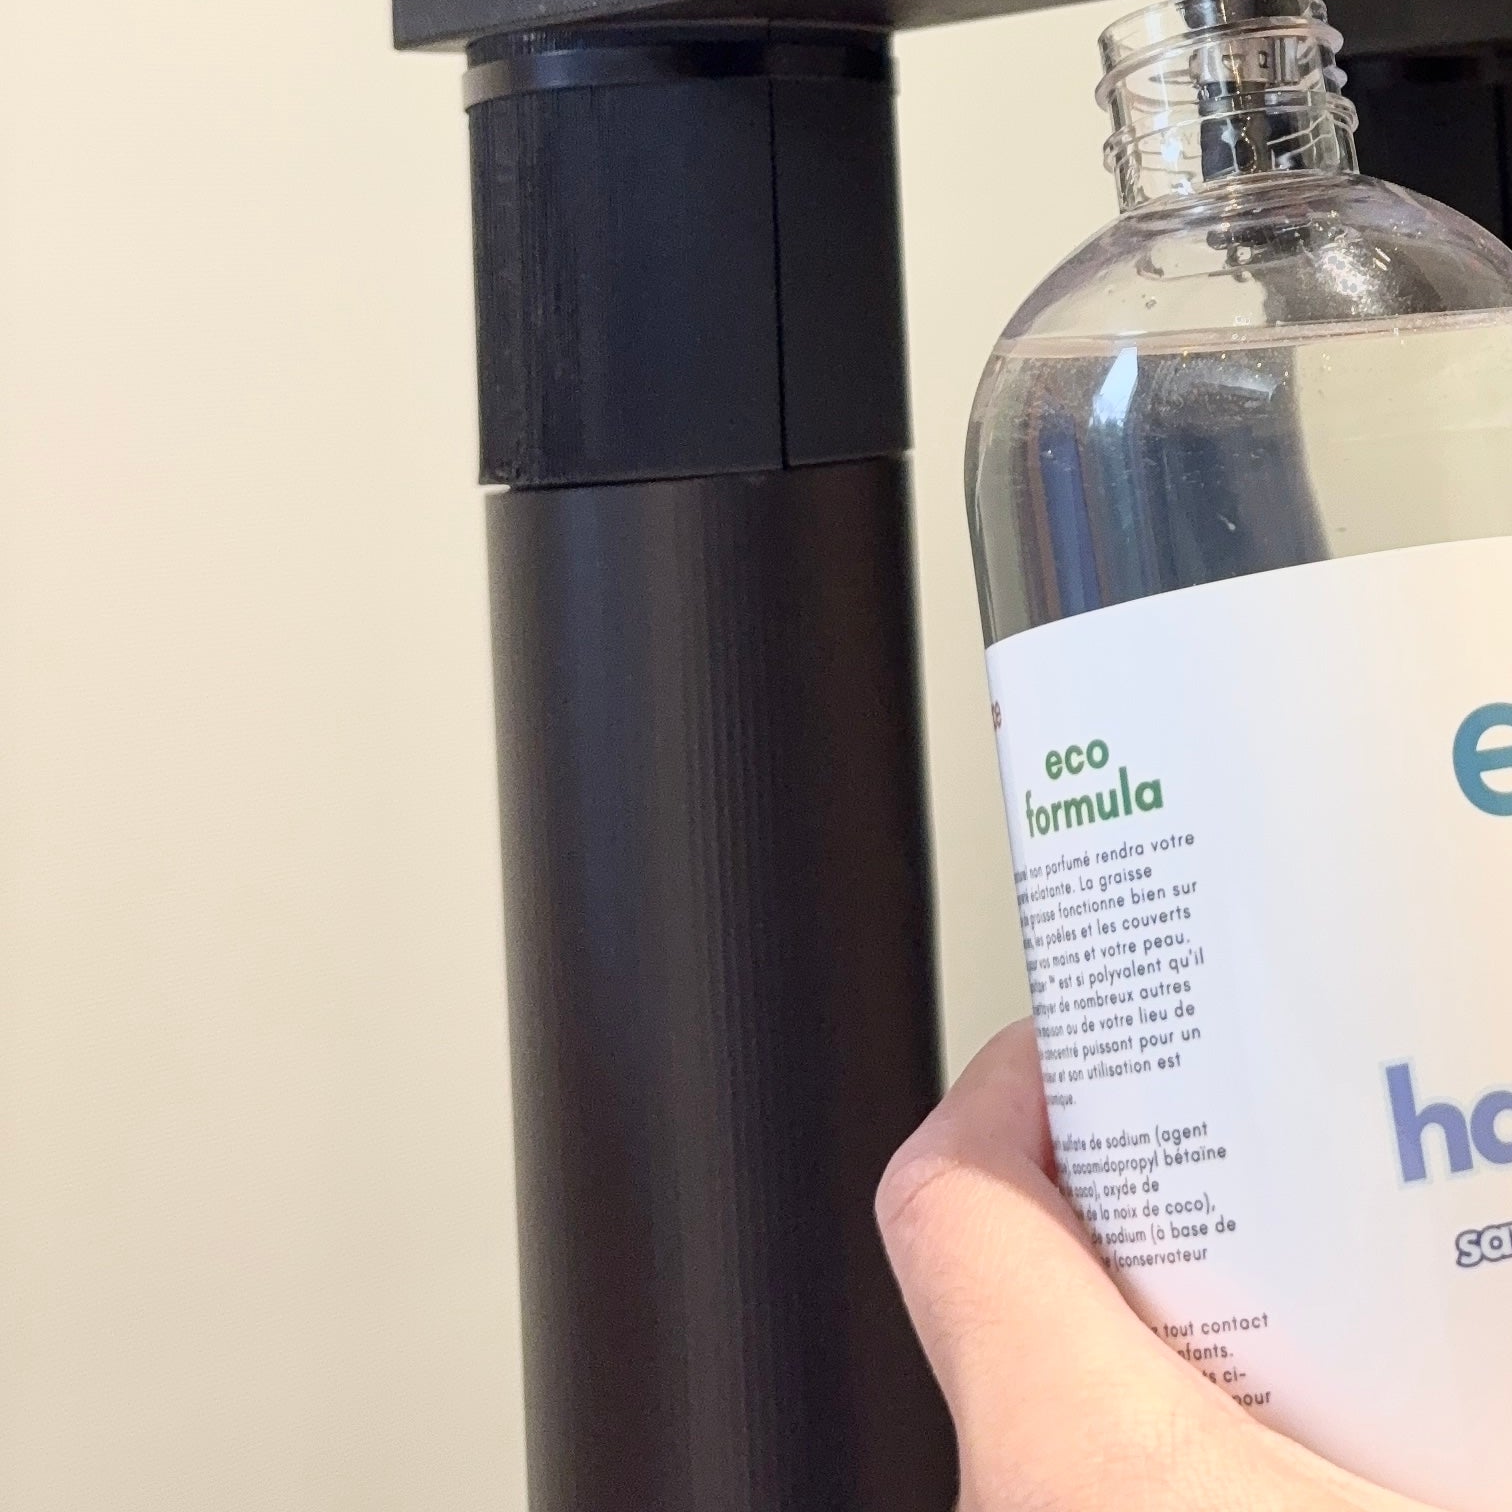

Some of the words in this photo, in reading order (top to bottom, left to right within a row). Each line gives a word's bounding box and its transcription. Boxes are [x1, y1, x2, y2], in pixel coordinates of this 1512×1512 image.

[1045, 738, 1110, 780] eco
[1025, 766, 1164, 838] formula
[1046, 851, 1090, 879] parfumé
[1096, 841, 1144, 863] rendra
[1151, 833, 1195, 852] votre
[1079, 876, 1094, 891] La
[1099, 866, 1153, 892] graisse
[1058, 896, 1125, 919] fonctionne
[1131, 886, 1166, 905] bien
[1172, 880, 1197, 897] sur
[1081, 923, 1092, 939] et
[1097, 919, 1117, 935] les
[1122, 905, 1192, 931] couverts
[1052, 949, 1080, 966] mains
[1084, 947, 1095, 962] et
[1100, 941, 1137, 959] votre
[1143, 932, 1190, 955] peau.
[1059, 976, 1072, 990] est
[1076, 972, 1085, 986] si
[1089, 958, 1162, 988] polyvalent
[1169, 947, 1205, 974] qu'il
[1059, 996, 1070, 1013] de
[1073, 990, 1134, 1010] nombreux
[1139, 980, 1191, 999] autres
[1066, 1022, 1078, 1036] ou
[1081, 1015, 1095, 1032] de
[1100, 1014, 1134, 1030] votre
[1138, 1006, 1168, 1024] lieu
[1174, 1000, 1195, 1017] de
[1082, 1036, 1133, 1061] puissant
[1139, 1031, 1174, 1053] pour
[1181, 1026, 1201, 1041] un
[1068, 1069, 1084, 1082] son
[1087, 1059, 1152, 1081] utilisation
[1157, 1052, 1181, 1070] est
[1089, 1133, 1102, 1150] de
[1106, 1129, 1150, 1150] sodium
[1155, 1121, 1208, 1147] (agent
[1164, 1145, 1227, 1167] bétaïne
[1103, 1177, 1137, 1200] oxyde
[1142, 1175, 1159, 1193] de
[1100, 1204, 1110, 1220] la
[1113, 1204, 1138, 1220] noix
[1142, 1199, 1159, 1217] de
[1165, 1191, 1215, 1215] coco),
[1106, 1226, 1146, 1245] sodium
[1170, 1221, 1208, 1239] base
[1215, 1214, 1236, 1233] de
[1114, 1247, 1208, 1272] (conservateur
[1164, 1321, 1194, 1338] tout
[1201, 1312, 1268, 1335] contact
[1223, 1366, 1246, 1383] ci-
